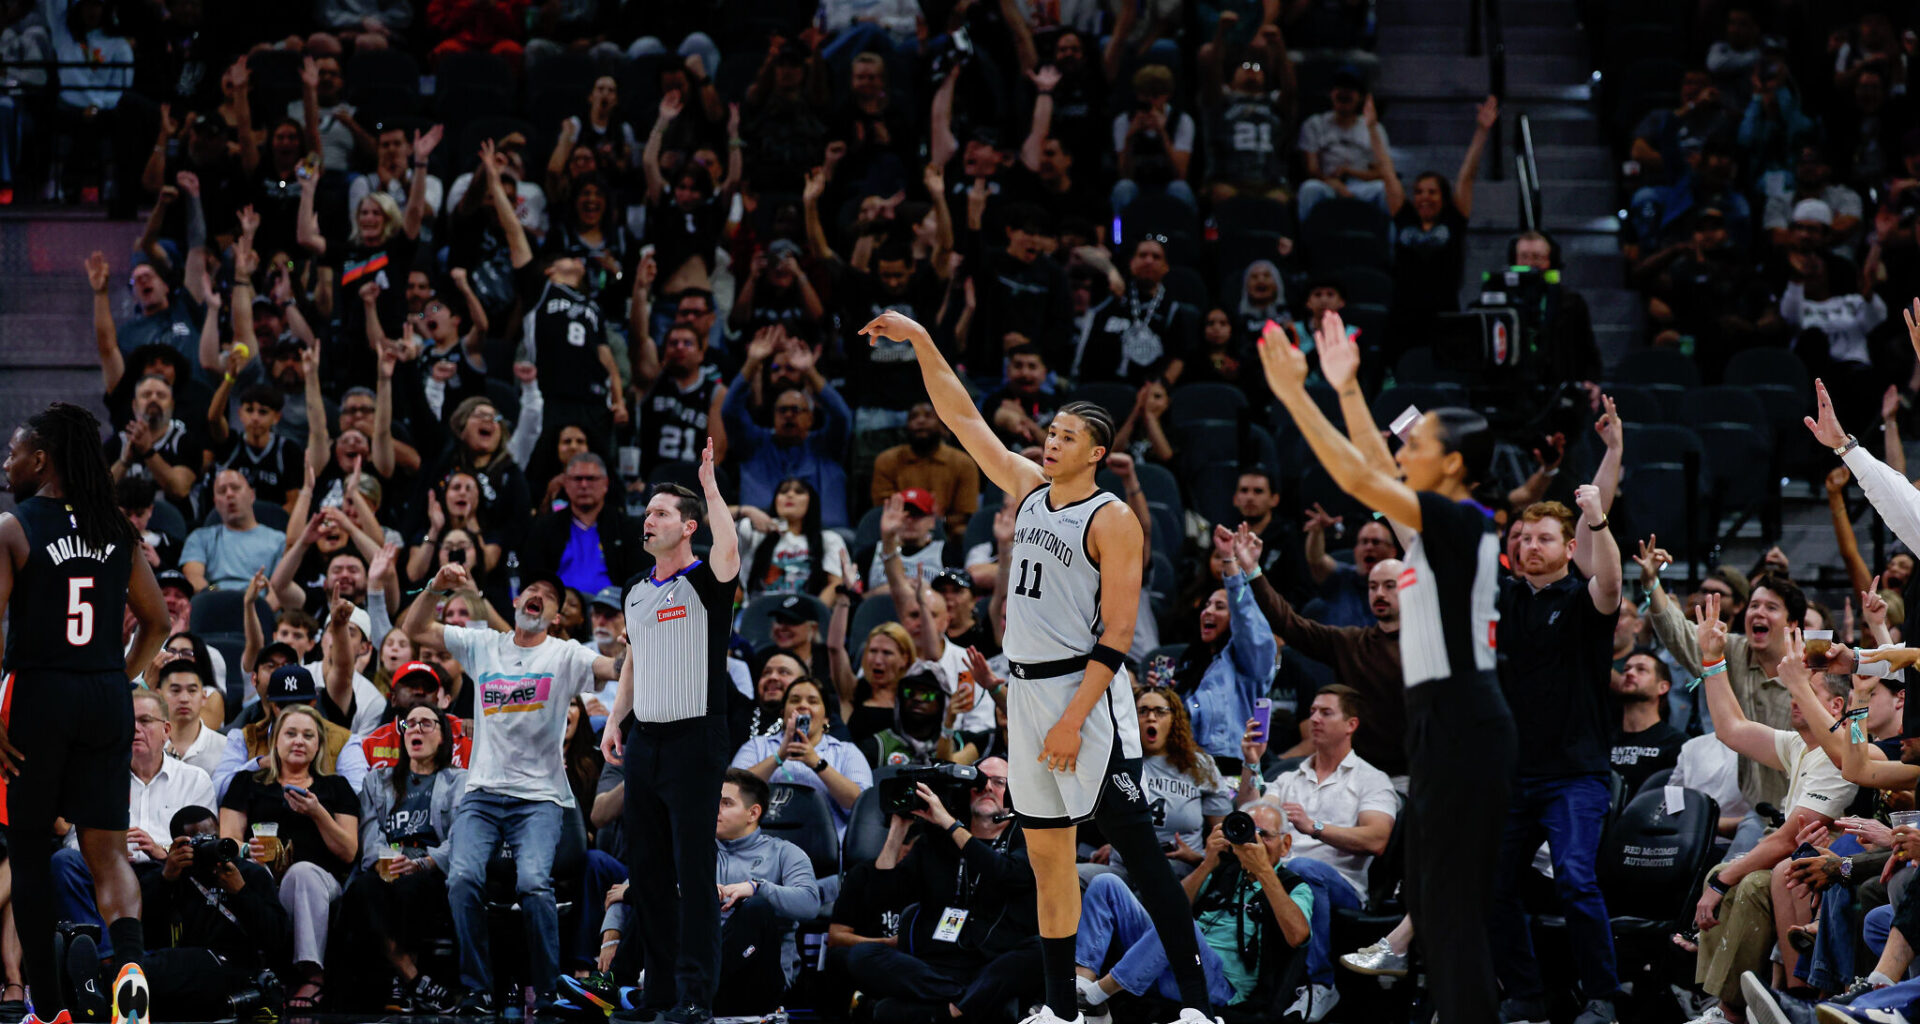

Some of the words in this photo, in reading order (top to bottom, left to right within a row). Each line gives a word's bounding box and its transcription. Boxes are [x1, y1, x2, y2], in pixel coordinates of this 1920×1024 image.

[1233, 121, 1274, 152] 21
[567, 321, 585, 346] 8
[659, 424, 696, 462] 21
[1025, 527, 1073, 568] ANTONIO
[1015, 558, 1042, 600] 11
[66, 577, 95, 646] 5
[658, 609, 686, 620] Emirates
[284, 676, 298, 692] NY
[1611, 746, 1660, 758] ANTONIO
[1148, 778, 1196, 799] ANTONIO
[1623, 845, 1641, 855] RED
[1623, 856, 1674, 867] AUTOMOTIVE
